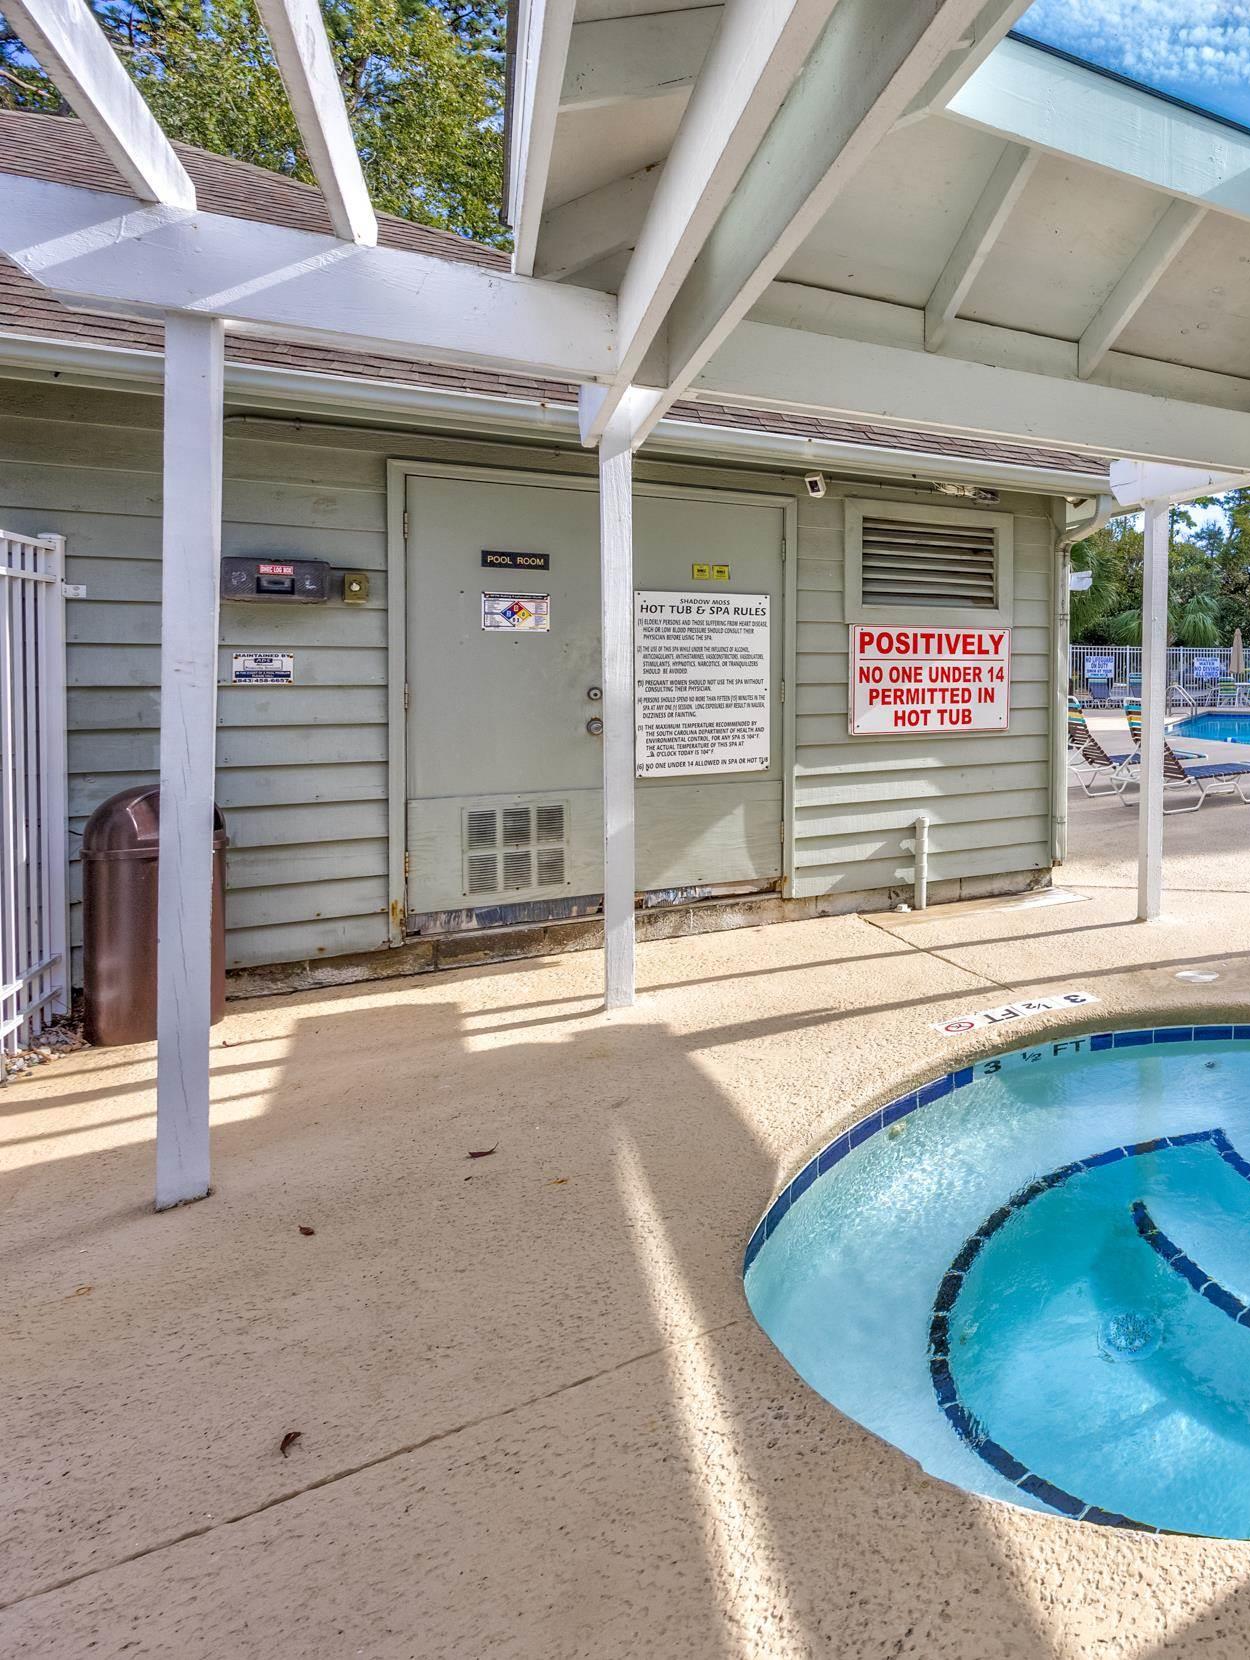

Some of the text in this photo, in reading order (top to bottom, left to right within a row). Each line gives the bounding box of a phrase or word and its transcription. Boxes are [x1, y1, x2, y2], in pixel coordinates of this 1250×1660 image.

[487, 555, 544, 565] POOL ROOM
[640, 604, 766, 616] HOT TUB & SPA RULES
[859, 632, 1004, 655] POSITIVELY
[859, 666, 1004, 683] NO ONE UNDER 14
[869, 687, 994, 705] PERMITTED IN
[894, 708, 972, 727] HOT TUB
[1064, 994, 1086, 1003] 3
[983, 1008, 1020, 1024] FT
[984, 1060, 1001, 1074] 3
[1053, 1039, 1086, 1056] FT
